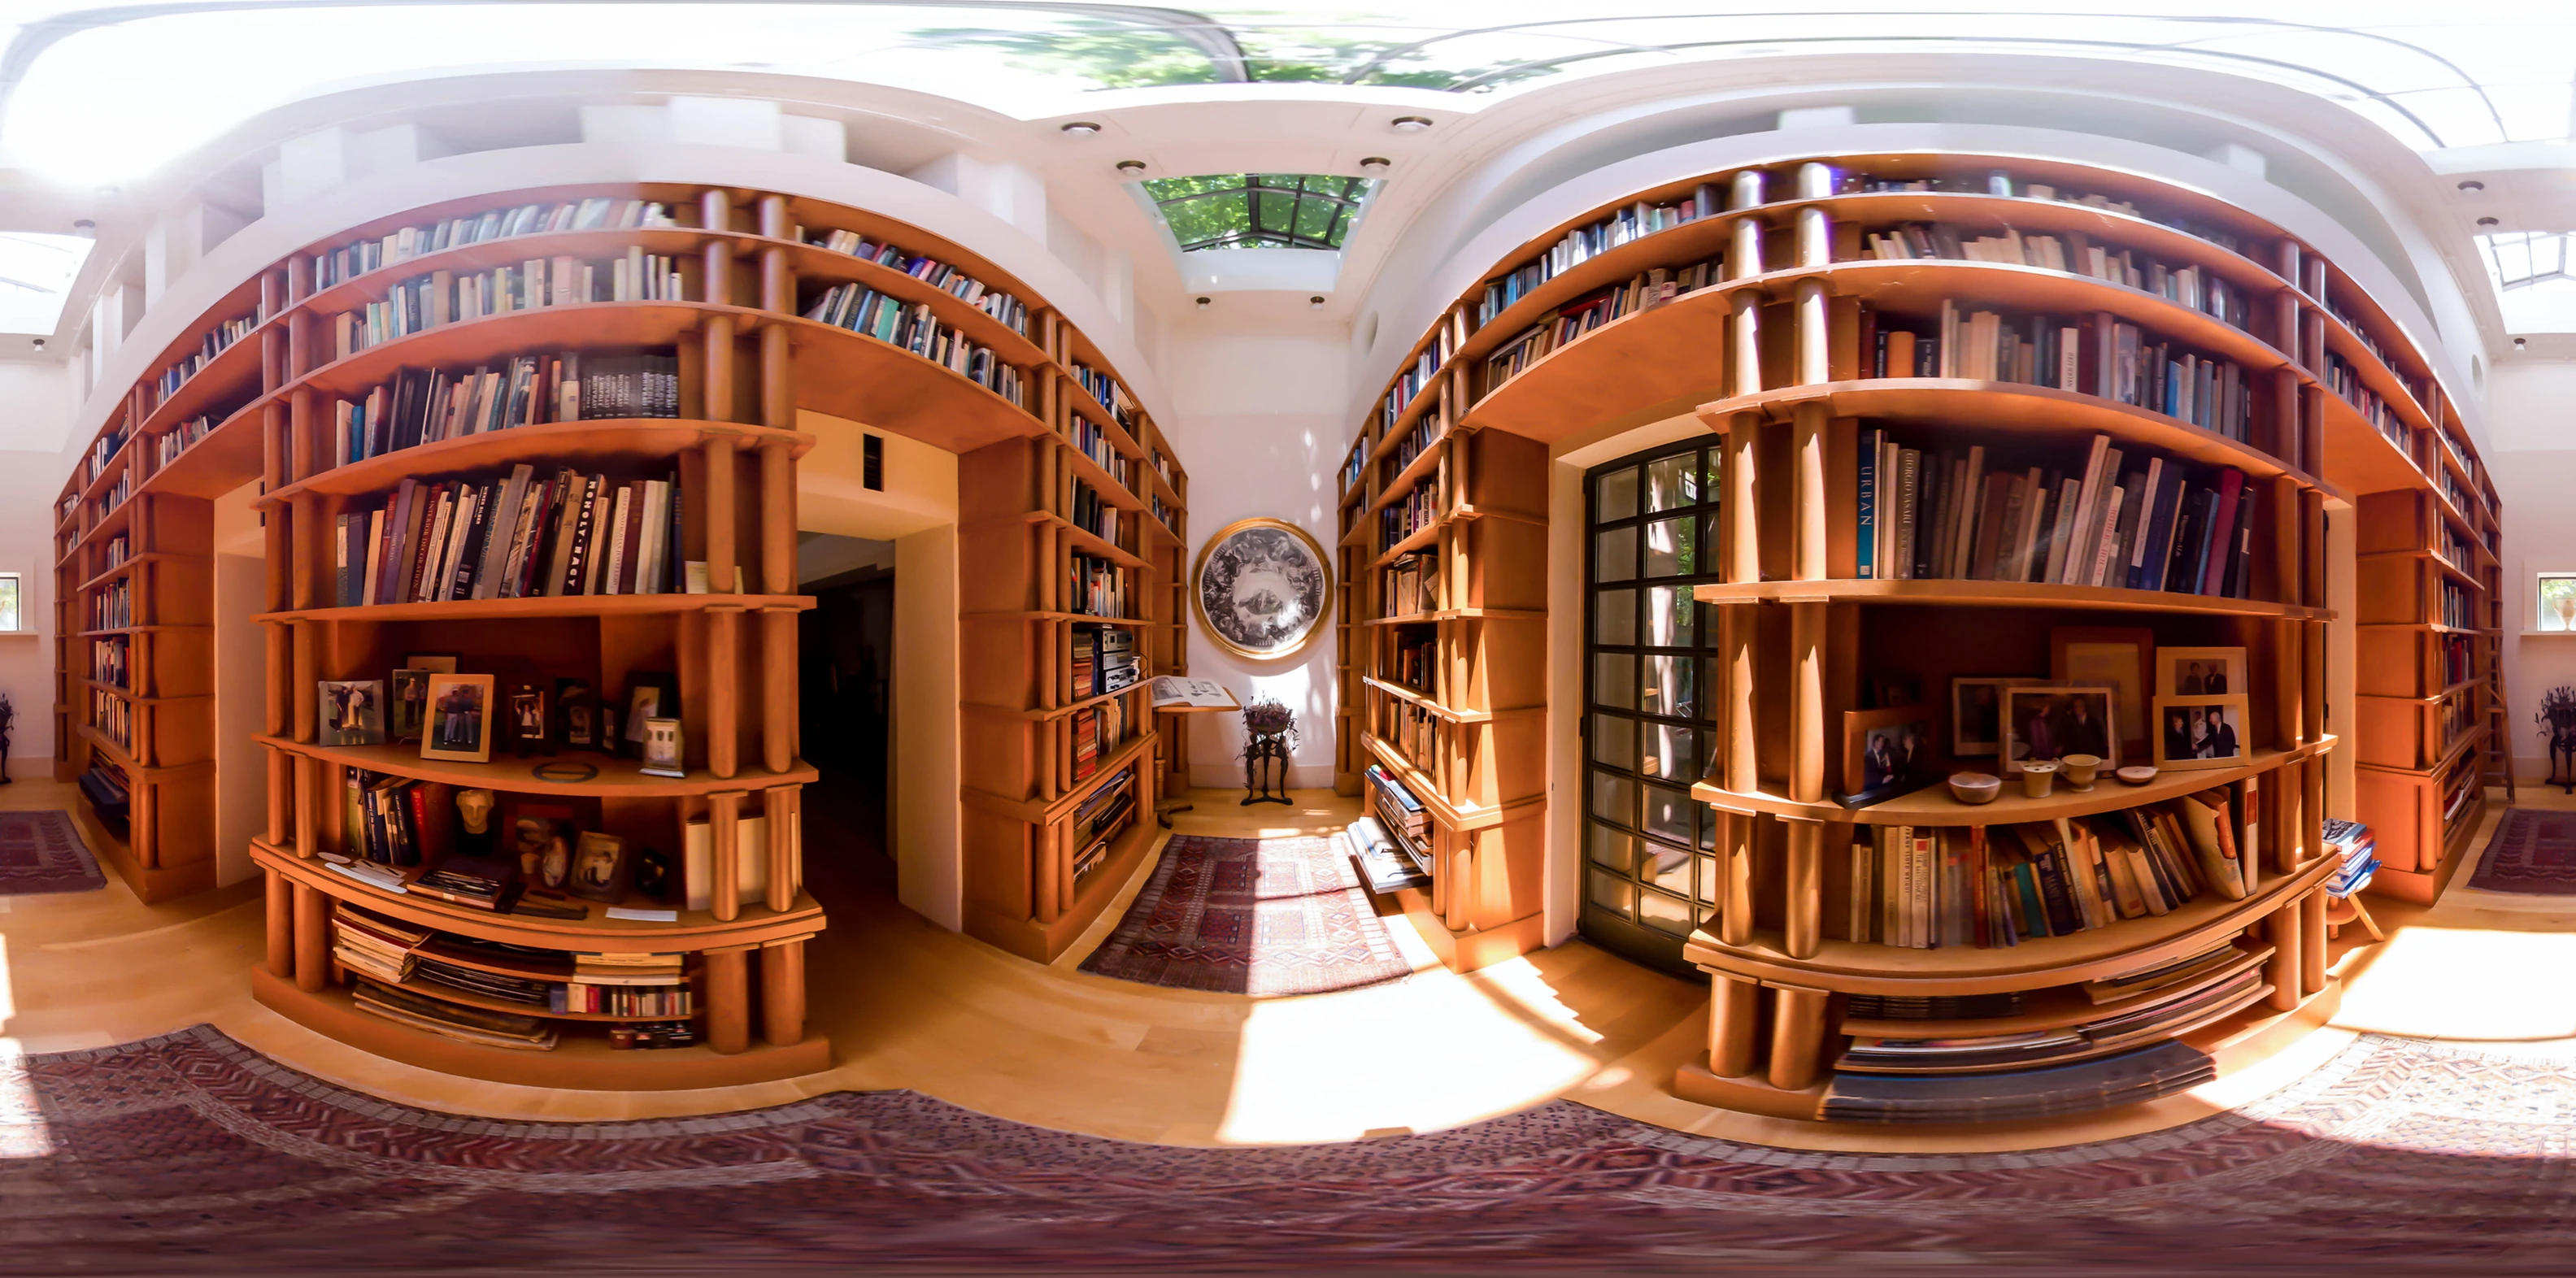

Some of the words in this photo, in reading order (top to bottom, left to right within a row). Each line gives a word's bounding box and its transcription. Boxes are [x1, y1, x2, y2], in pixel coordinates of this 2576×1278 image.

[1904, 453, 1915, 492] GIORGIO
[479, 485, 489, 506] WIENER
[1860, 466, 1873, 526] URBAN
[1902, 493, 1913, 524] VASARI
[423, 500, 435, 537] INTERIOR
[476, 506, 485, 525] SILBER
[567, 480, 596, 587] MOHOLY-NAGY
[485, 530, 494, 544] IN
[413, 537, 428, 589] DECORATION
[613, 550, 623, 586] JEWELLERY
